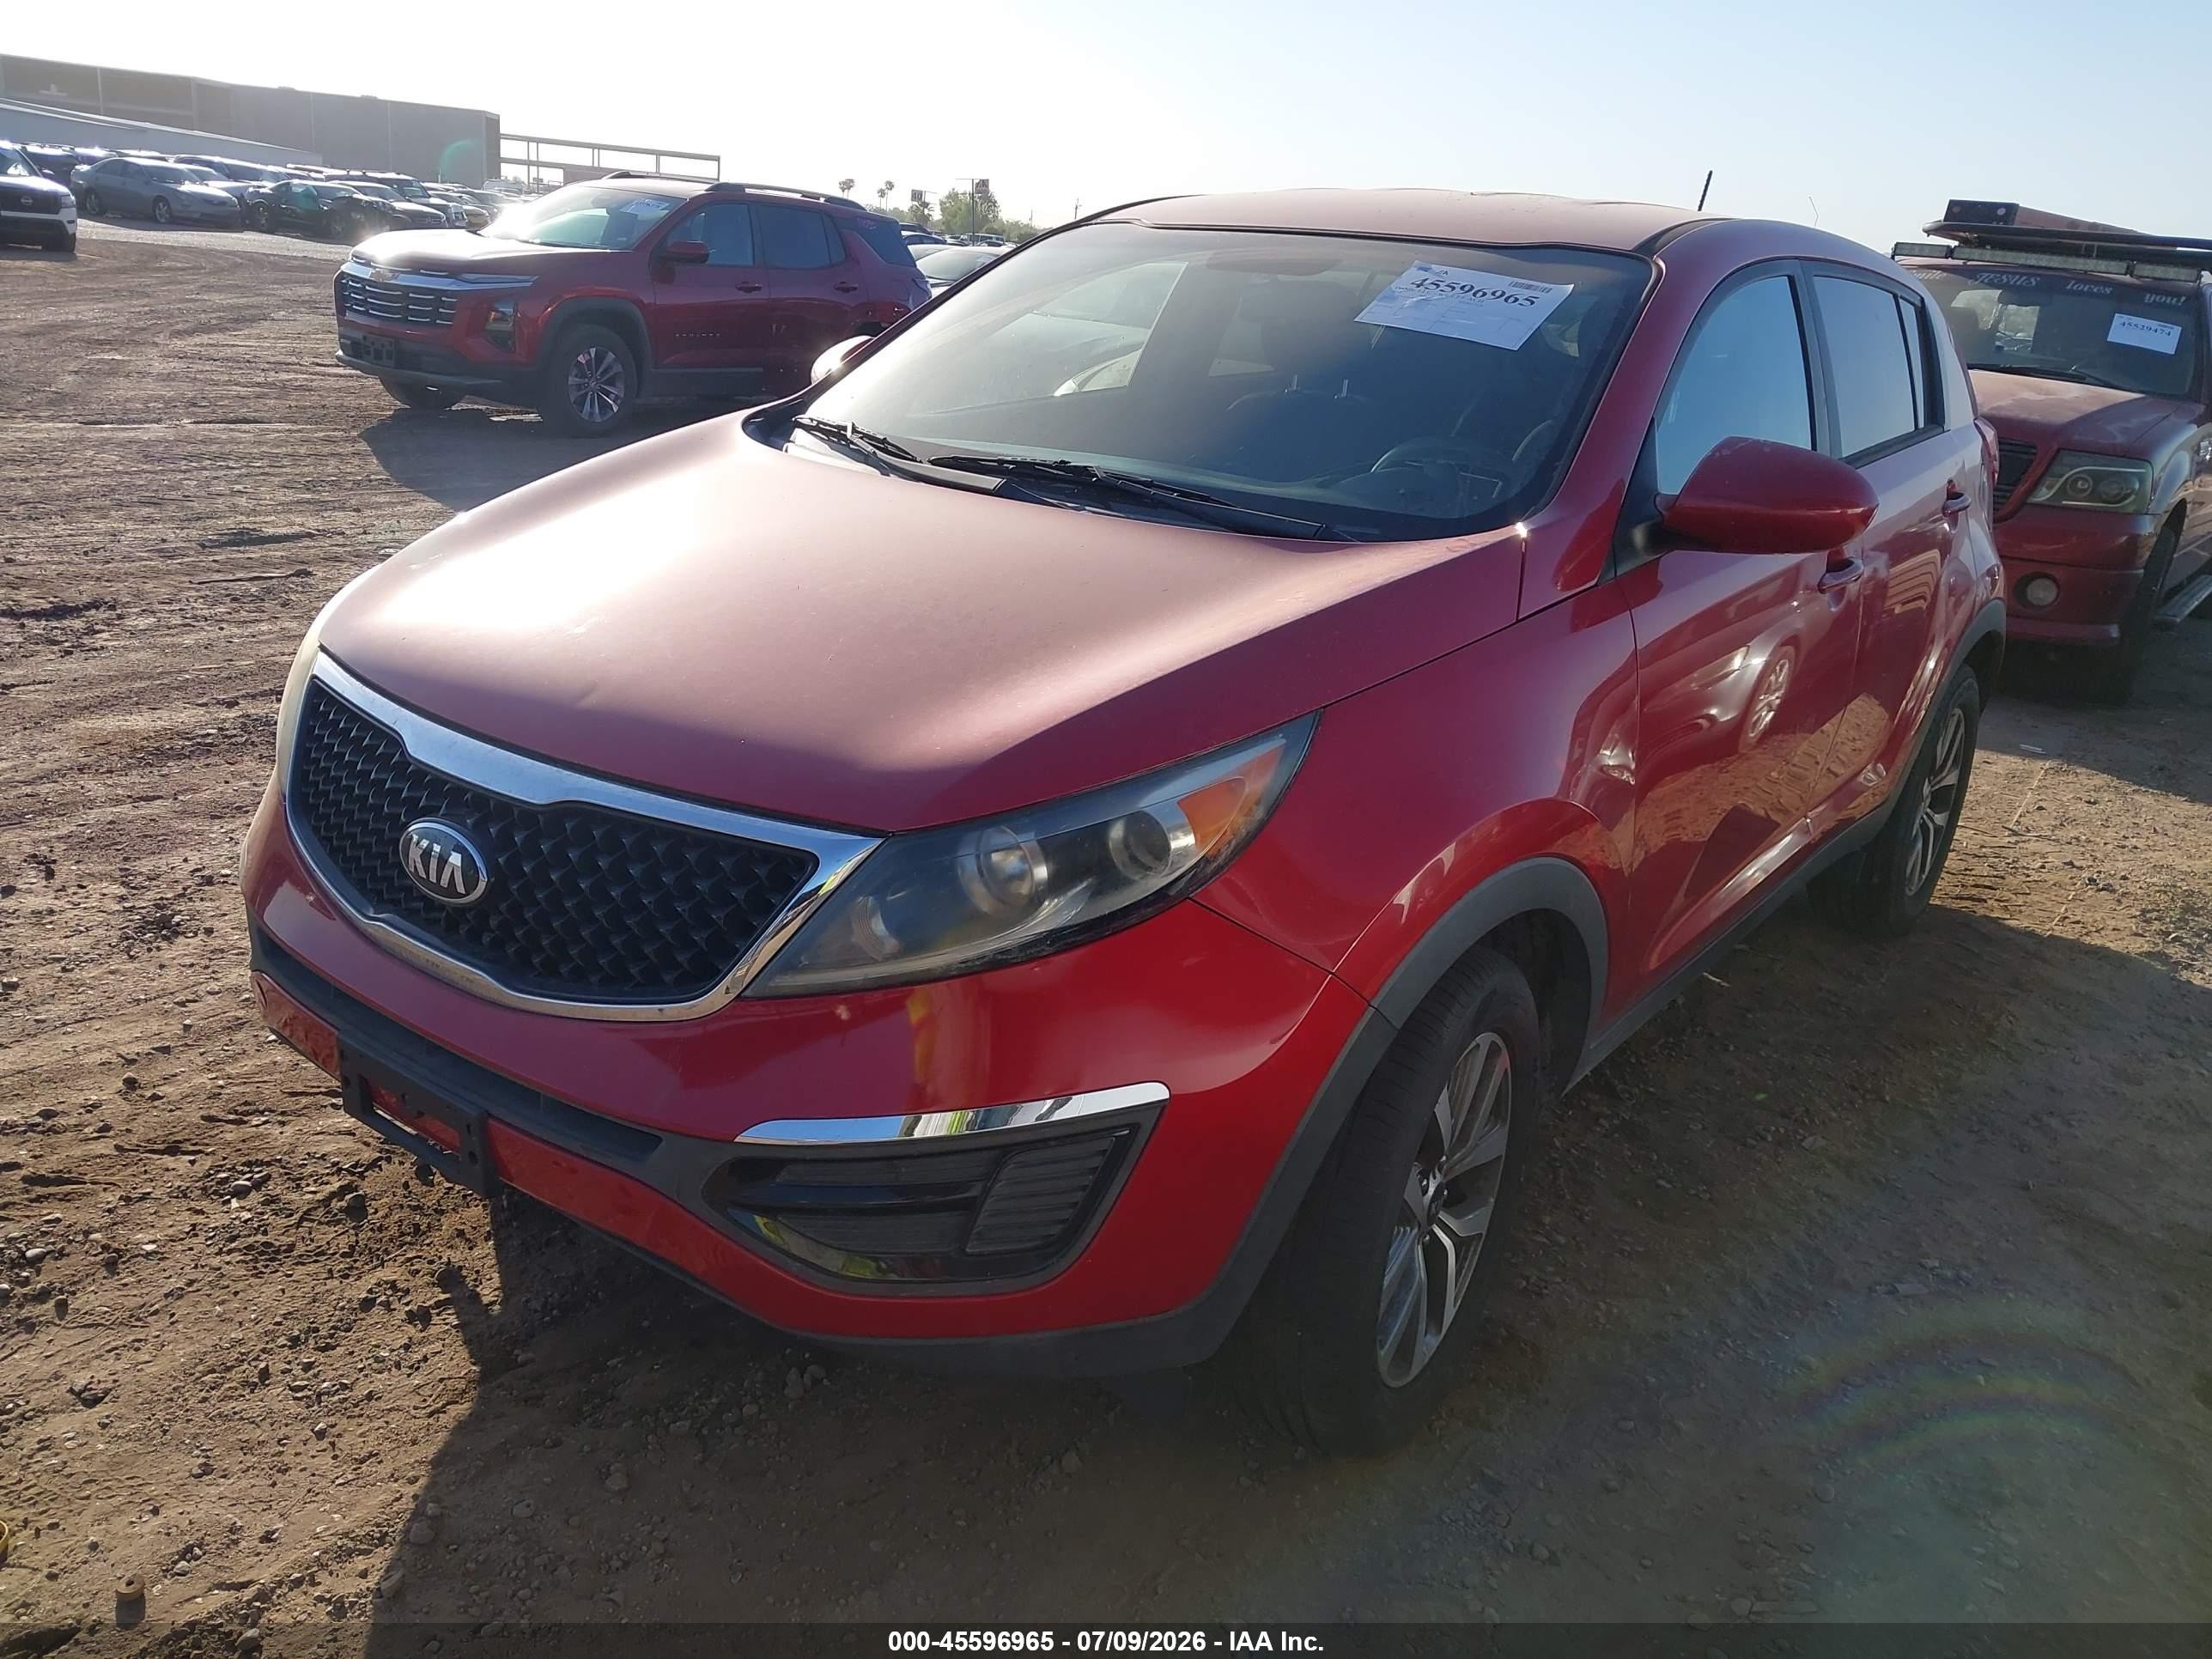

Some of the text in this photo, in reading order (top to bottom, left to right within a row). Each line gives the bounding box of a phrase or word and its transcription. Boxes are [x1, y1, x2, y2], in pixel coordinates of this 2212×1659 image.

[1411, 277, 1540, 307] 45596965
[2065, 280, 2113, 294] loves
[2144, 293, 2187, 306] you!
[408, 834, 466, 895] KIA
